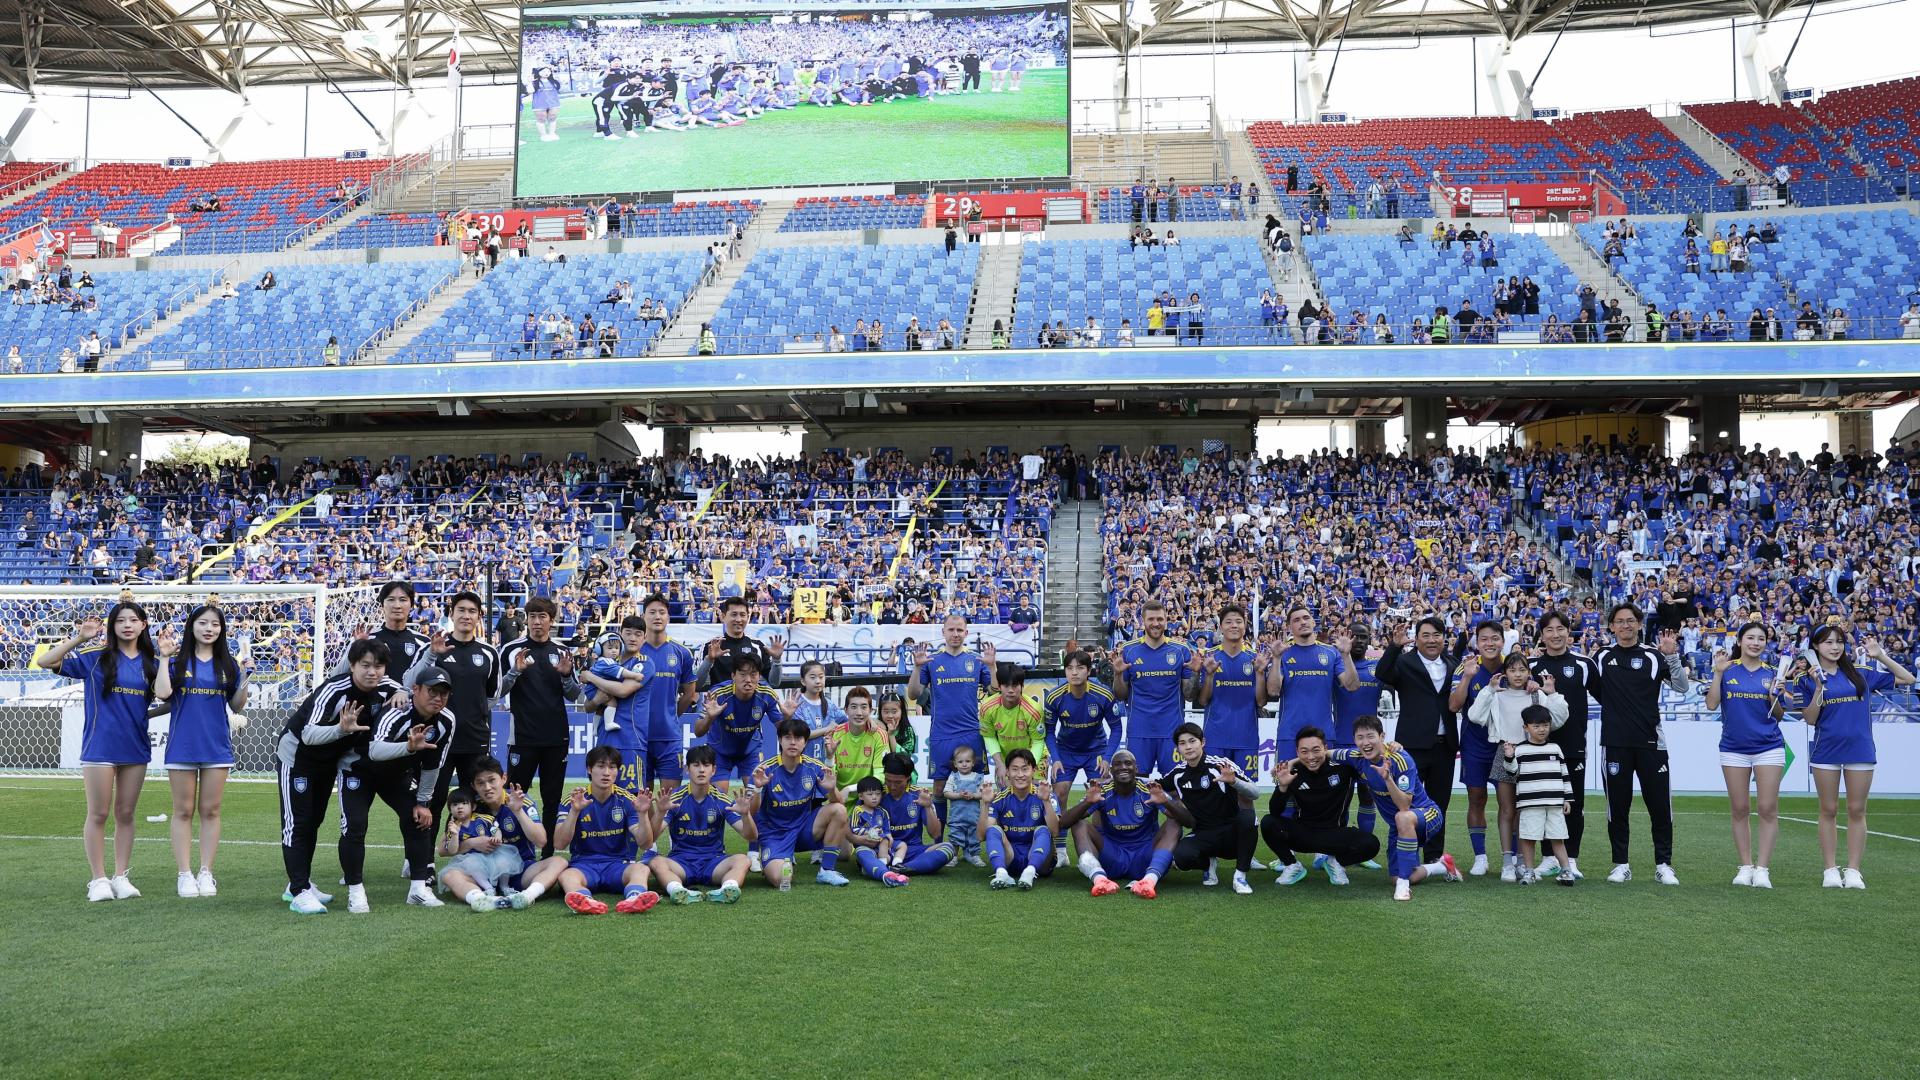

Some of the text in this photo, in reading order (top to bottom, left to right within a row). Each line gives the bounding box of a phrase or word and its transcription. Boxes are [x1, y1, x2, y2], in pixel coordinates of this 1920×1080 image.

[1789, 91, 1806, 99] S34
[1538, 110, 1552, 118] S33
[1445, 186, 1473, 205] 28
[943, 196, 972, 216] 29
[478, 215, 505, 233] 30
[800, 590, 818, 613] 빛
[1245, 755, 1259, 770] 28
[619, 764, 636, 781] 24
